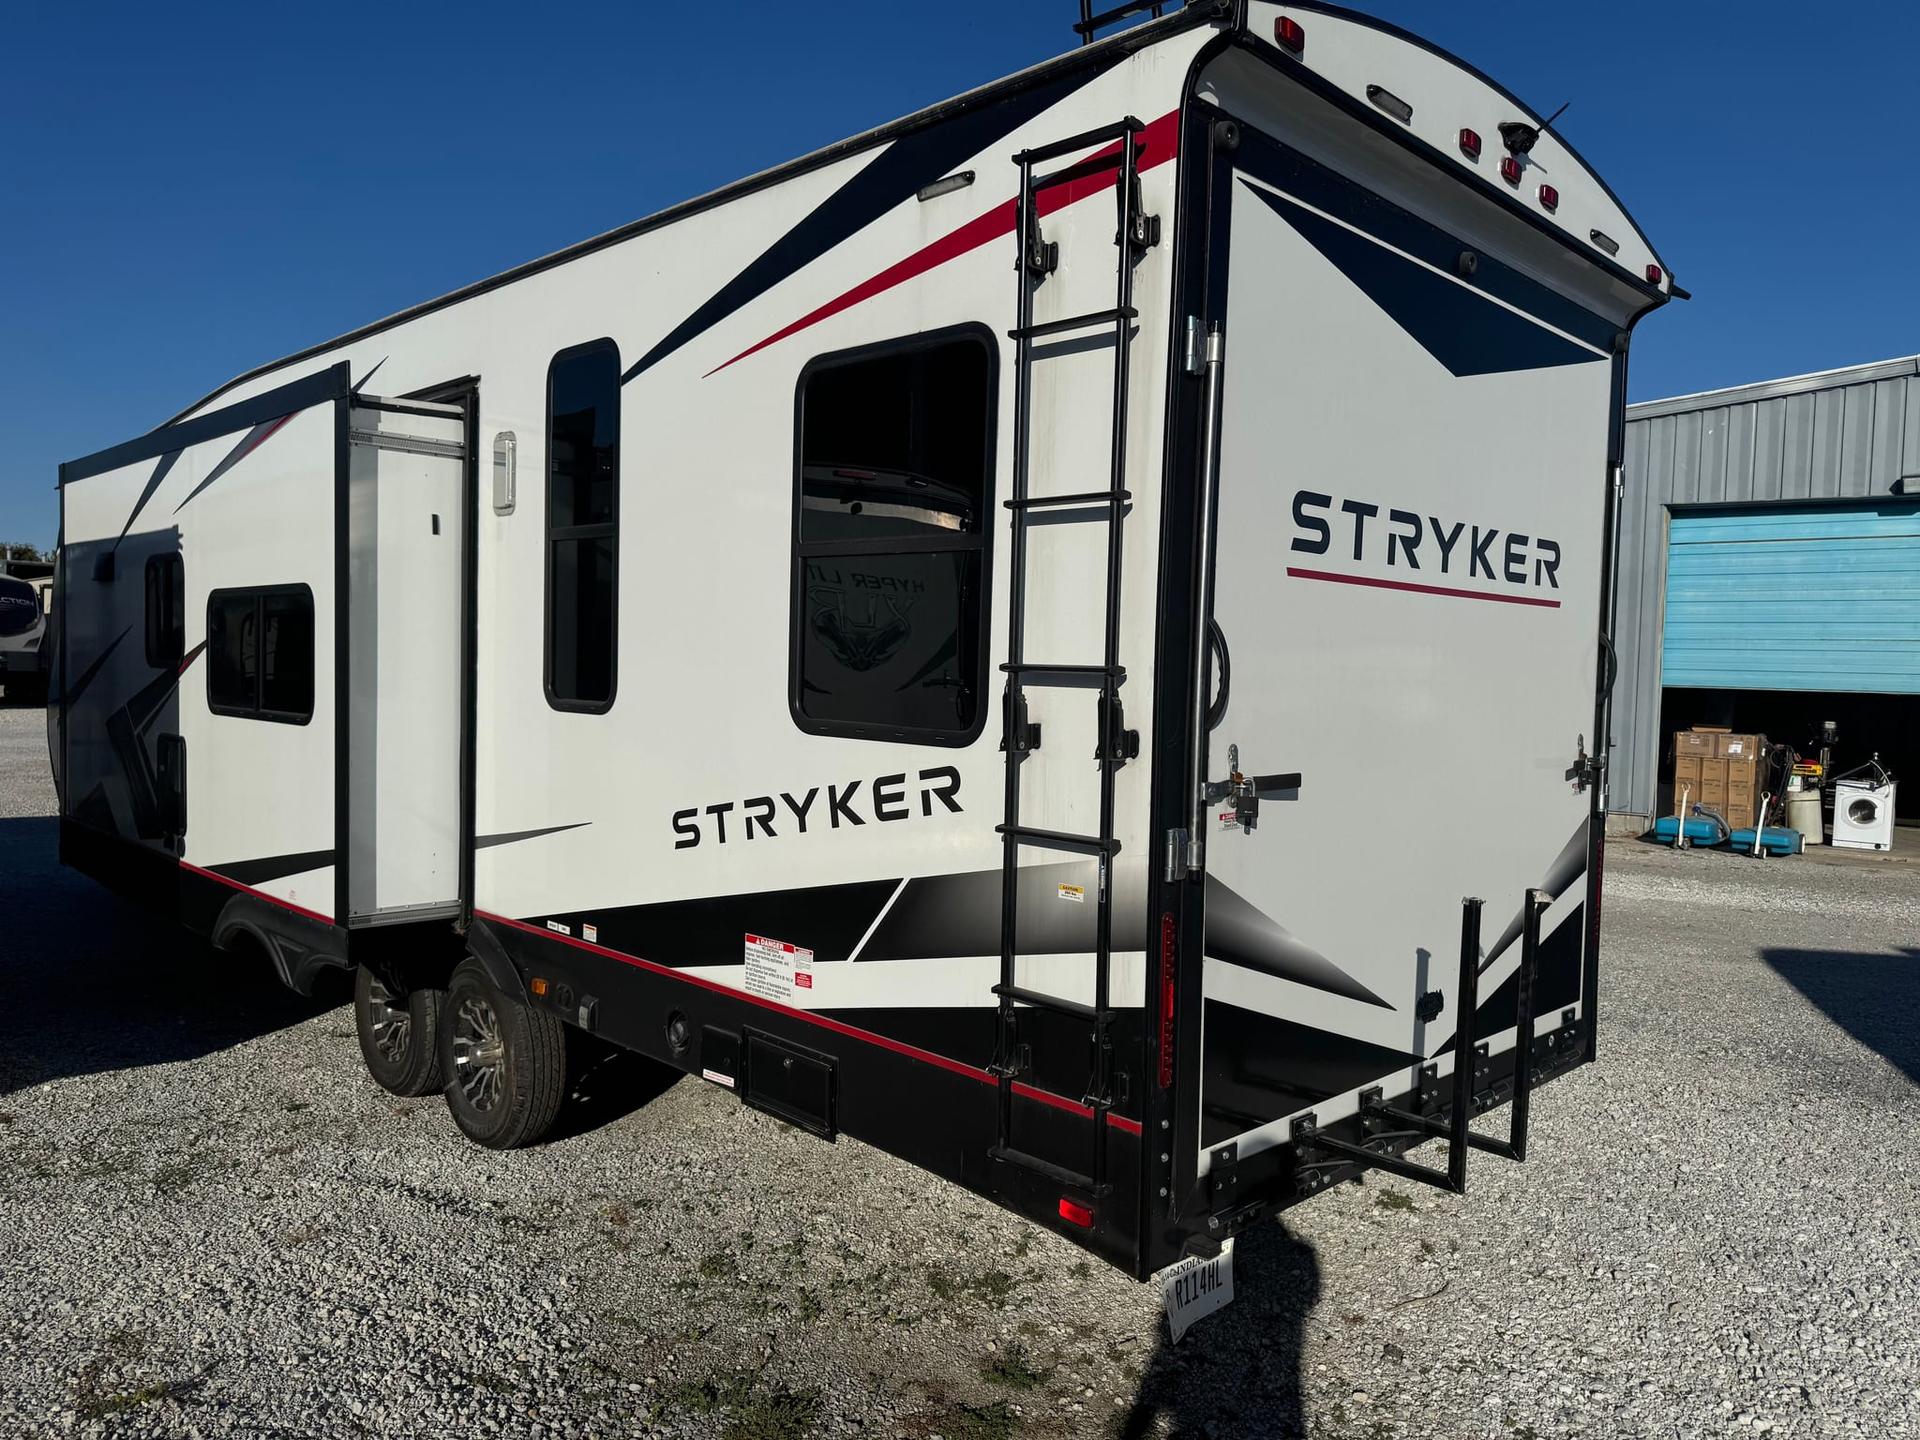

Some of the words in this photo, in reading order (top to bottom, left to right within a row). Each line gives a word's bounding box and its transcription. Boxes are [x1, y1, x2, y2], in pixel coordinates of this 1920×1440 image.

[1290, 489, 1561, 589] STRYKER
[672, 765, 964, 850] STRYKER
[761, 939, 784, 950] DANGER
[1175, 1260, 1222, 1310] R114HL
